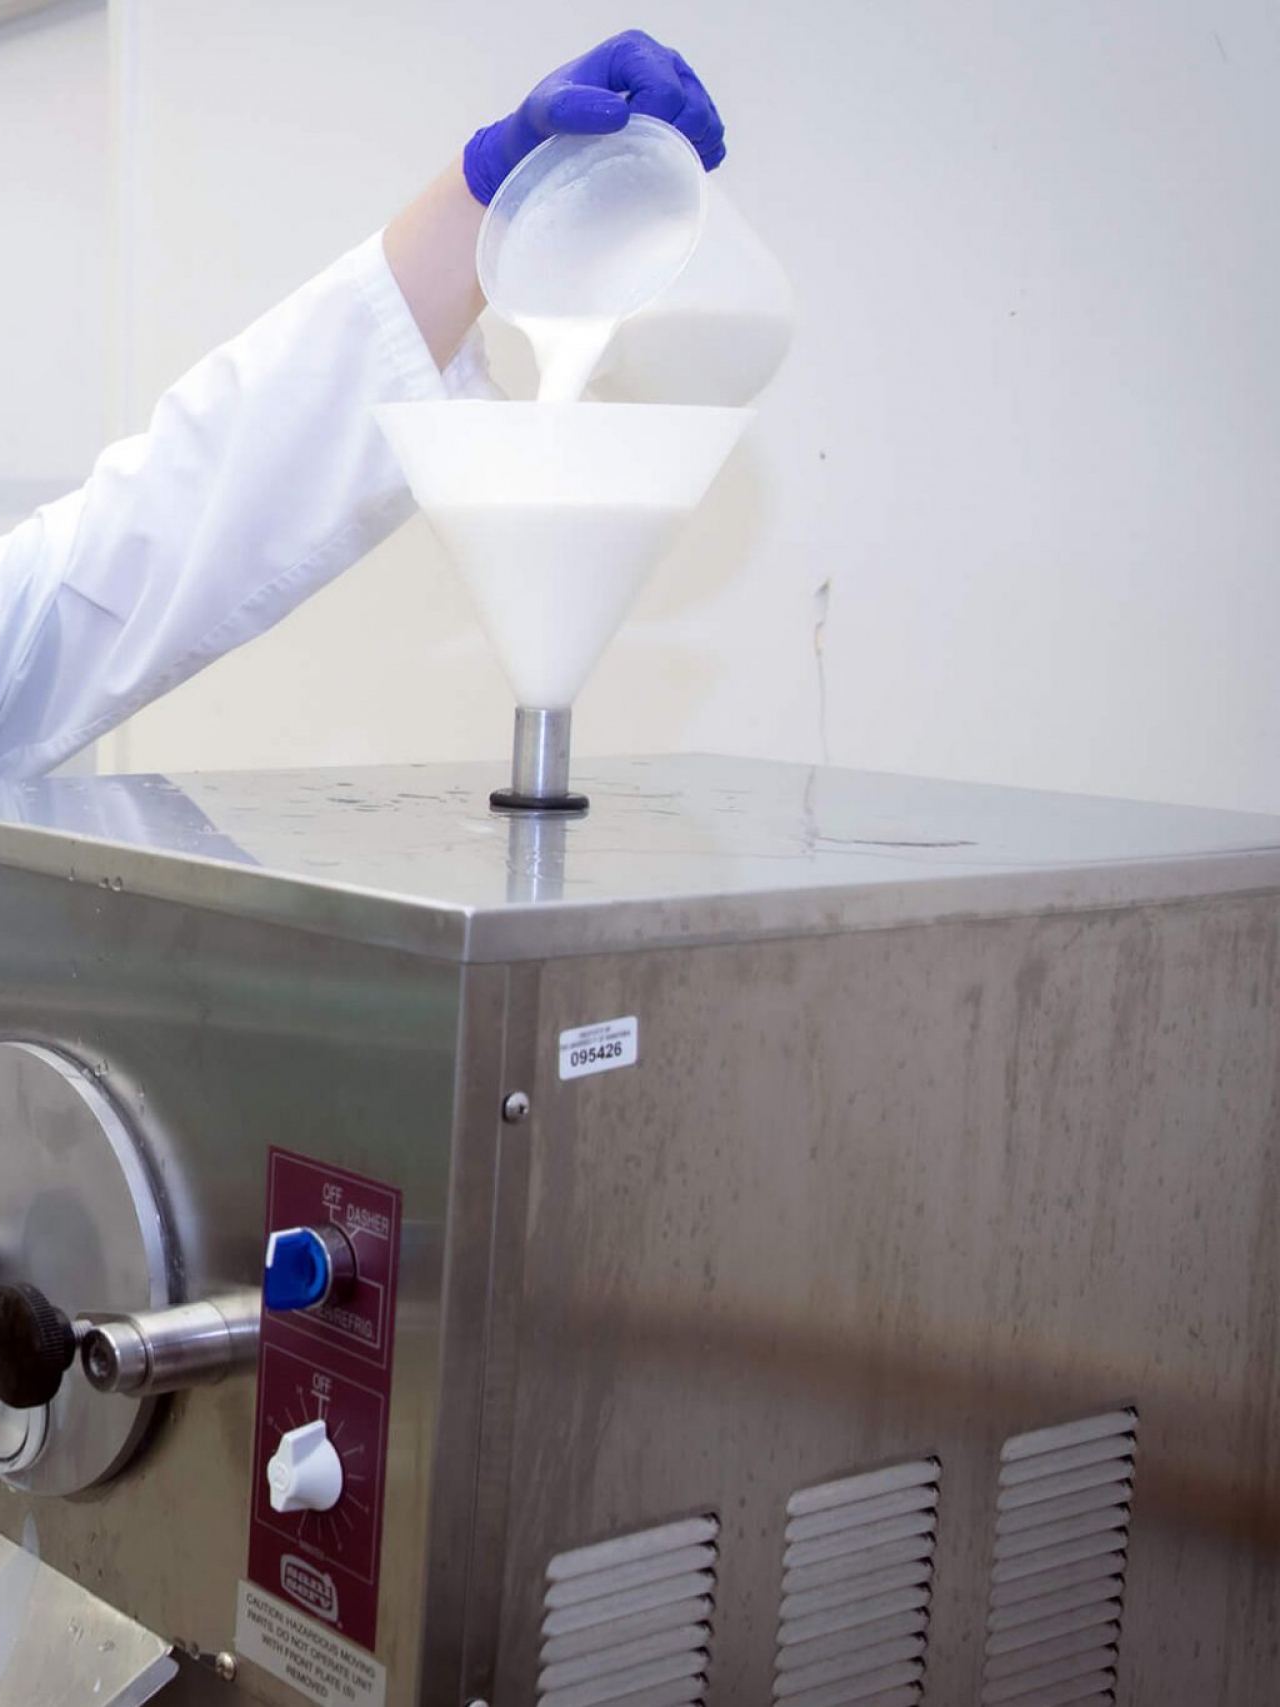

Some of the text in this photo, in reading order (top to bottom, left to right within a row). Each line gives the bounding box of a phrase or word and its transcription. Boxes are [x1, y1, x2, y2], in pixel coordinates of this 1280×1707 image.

[570, 1041, 622, 1067] 095426
[322, 1183, 344, 1203] OFF
[346, 1203, 389, 1234] DASHER
[312, 1373, 332, 1393] OFF
[261, 1632, 283, 1656] WITH
[285, 1647, 314, 1673] FRONT
[315, 1663, 342, 1690] PLATE
[276, 1625, 290, 1642] DO
[291, 1632, 310, 1652] NOT
[310, 1645, 350, 1680] OPERATE
[352, 1672, 373, 1693] UNIT
[286, 1616, 339, 1656] HAZARDOUS
[340, 1648, 376, 1680] MOVING
[286, 1664, 328, 1698] REMOVED
